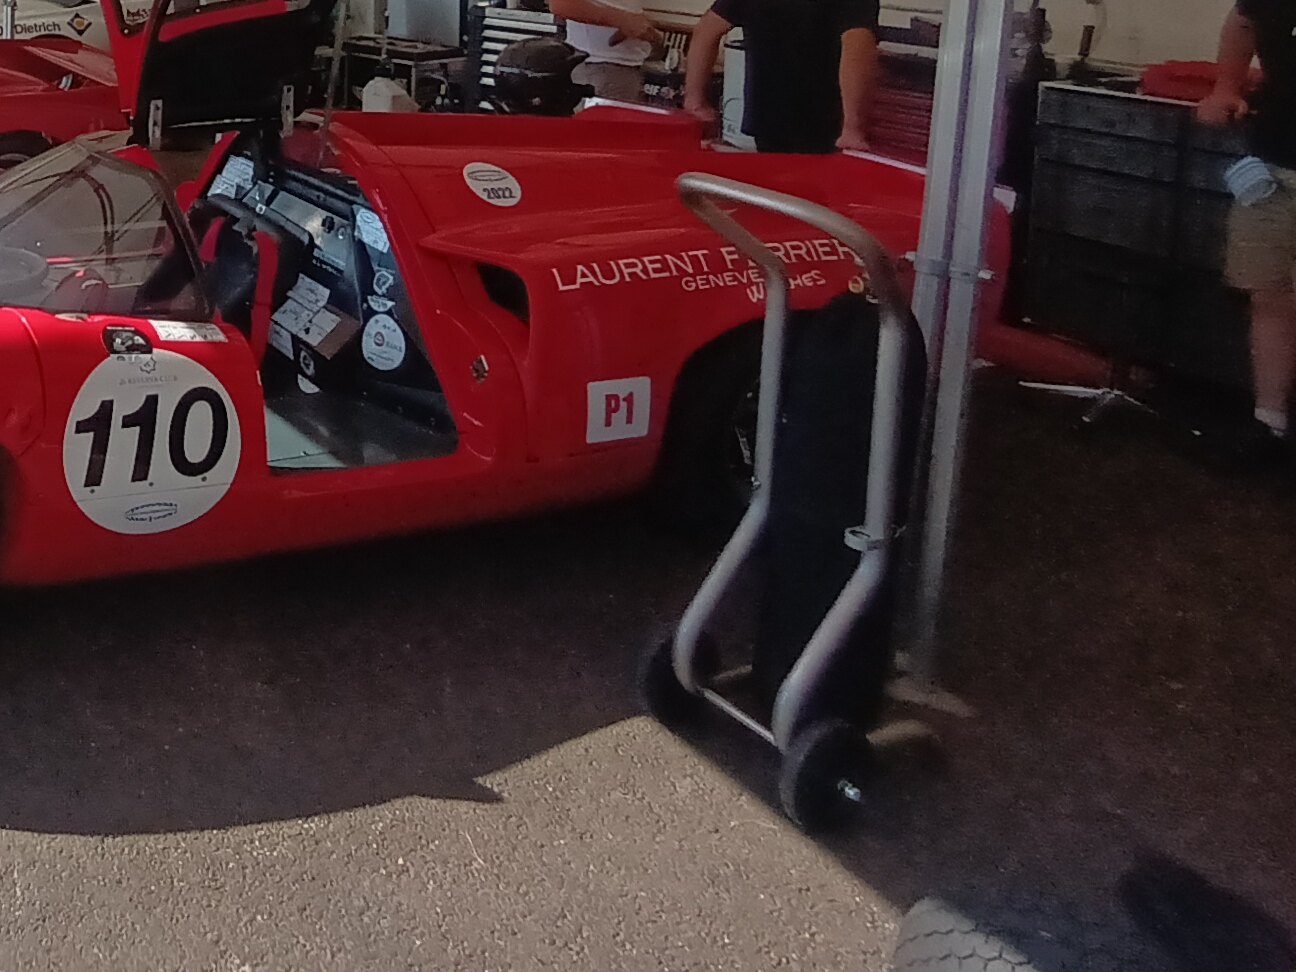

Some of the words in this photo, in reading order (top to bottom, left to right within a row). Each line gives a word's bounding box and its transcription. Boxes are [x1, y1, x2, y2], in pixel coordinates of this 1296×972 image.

[14, 21, 61, 35] Dietrich
[482, 186, 518, 200] 2022
[551, 249, 711, 292] LAURENT
[720, 238, 866, 269] FRRIER
[681, 269, 765, 292] GENEVE
[604, 391, 634, 428] P1
[74, 386, 229, 489] 110
